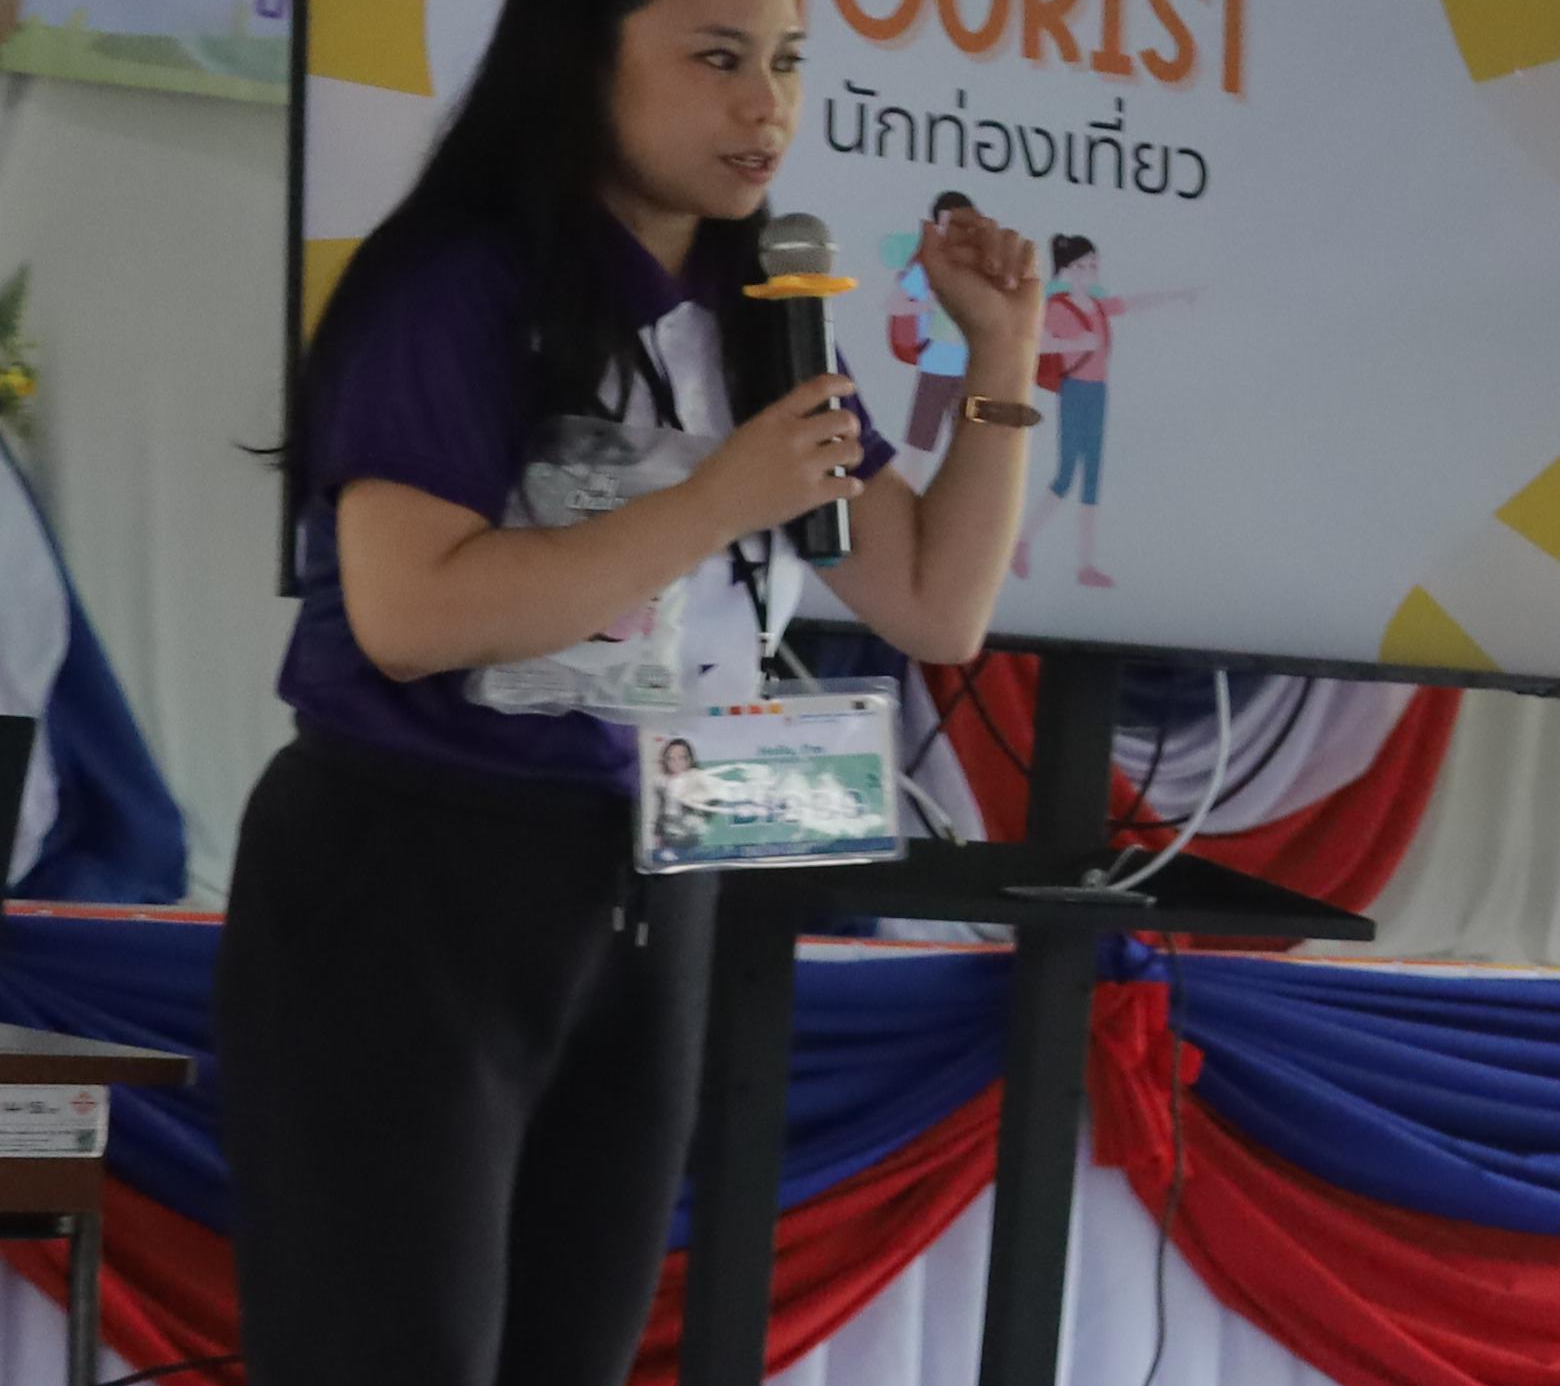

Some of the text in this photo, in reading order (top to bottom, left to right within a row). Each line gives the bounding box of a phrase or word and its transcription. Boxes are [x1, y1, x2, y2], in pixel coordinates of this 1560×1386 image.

[823, 78, 1210, 201] นักท่องเที่ยว
